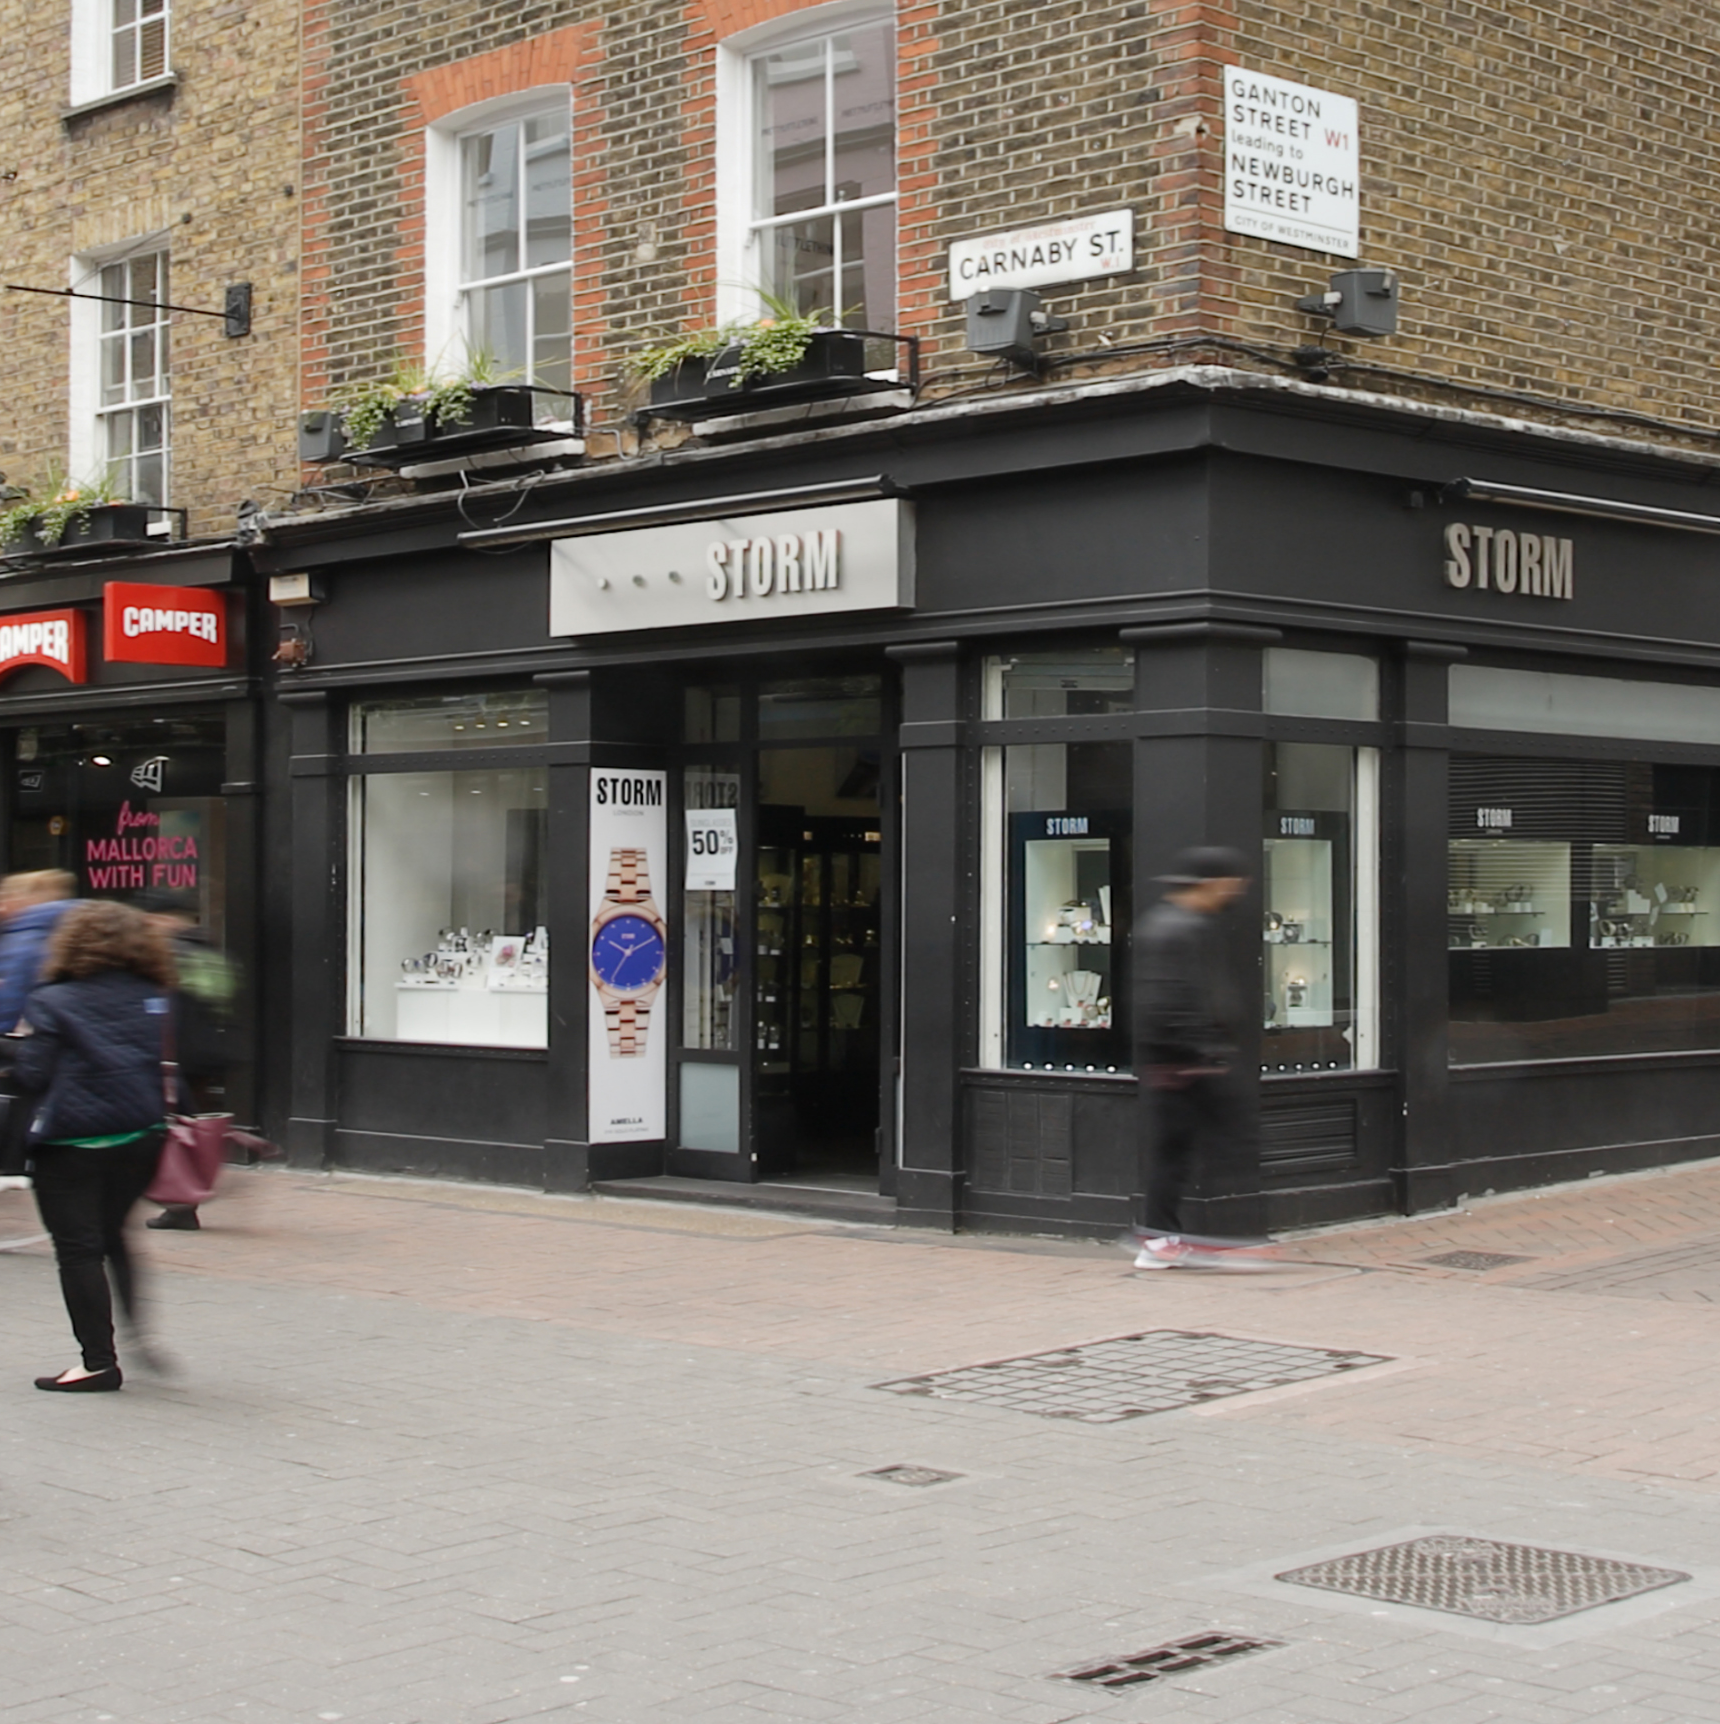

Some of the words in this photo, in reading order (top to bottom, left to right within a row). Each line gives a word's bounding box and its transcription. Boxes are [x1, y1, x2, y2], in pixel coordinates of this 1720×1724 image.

[1232, 79, 1321, 119] GANTON
[1231, 129, 1284, 158] leading
[1290, 144, 1304, 161] to
[1233, 104, 1312, 140] STREET
[1324, 127, 1349, 151] W1
[1231, 152, 1354, 200] NEWBURGH
[1233, 179, 1312, 214] STREET
[1234, 214, 1259, 228] CITY
[1261, 220, 1275, 232] OF
[1277, 225, 1350, 250] WESTMINSTER
[959, 237, 1079, 281] CARNABY
[1089, 229, 1124, 257] ST.
[704, 528, 842, 602] STORM
[1443, 522, 1575, 600] STORM
[124, 606, 218, 644] CAMPER
[596, 777, 662, 807] STORM
[116, 799, 161, 836] from
[1045, 817, 1089, 836] STORM
[1280, 817, 1316, 835] STORM
[1477, 808, 1513, 827] STORM
[1648, 814, 1680, 833] STORM
[87, 836, 198, 862] MALLORCA
[87, 864, 145, 889] WITH
[151, 862, 197, 887] FUN
